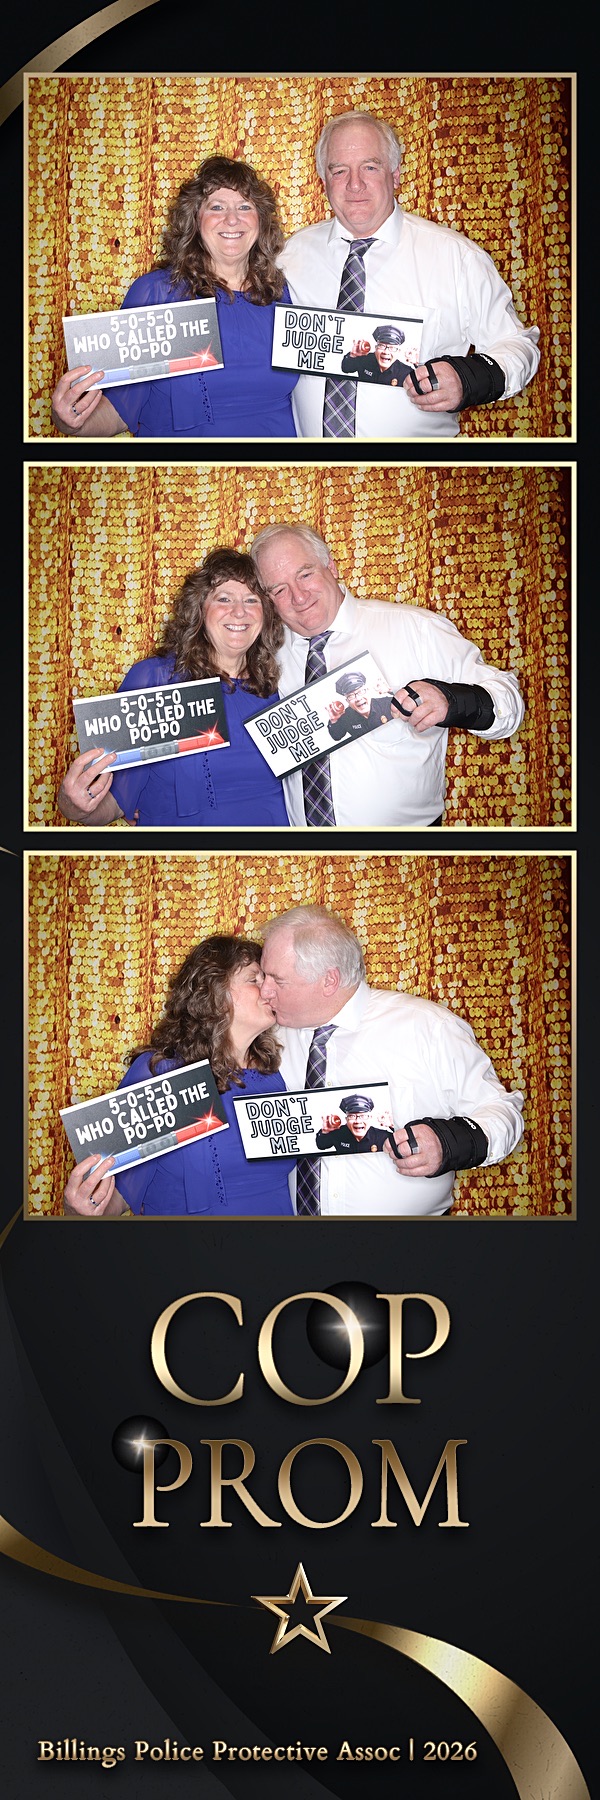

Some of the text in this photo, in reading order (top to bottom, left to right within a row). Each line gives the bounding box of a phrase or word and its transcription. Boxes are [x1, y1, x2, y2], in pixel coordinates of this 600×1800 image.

[110, 309, 174, 332] 5-0-5-0
[284, 310, 345, 334] DON'T
[73, 319, 210, 354] WHO CALLED THE
[282, 330, 344, 354] JUDGE
[119, 340, 172, 363] PO-PO
[298, 350, 325, 370] ME
[120, 689, 181, 713] 5-0-5-0
[84, 698, 216, 736] WHO CALLED THE
[255, 694, 312, 738] DON'T
[130, 721, 180, 744] PO-PO
[270, 711, 324, 754] JUDGE
[288, 737, 320, 763] ME
[109, 1080, 172, 1114] 5-0-5-0
[246, 1097, 308, 1120] DON'T
[75, 1082, 210, 1145] WHO CALLED THE
[123, 1112, 176, 1144] PO-PO
[250, 1116, 314, 1138] JUDGE
[270, 1135, 300, 1154] ME
